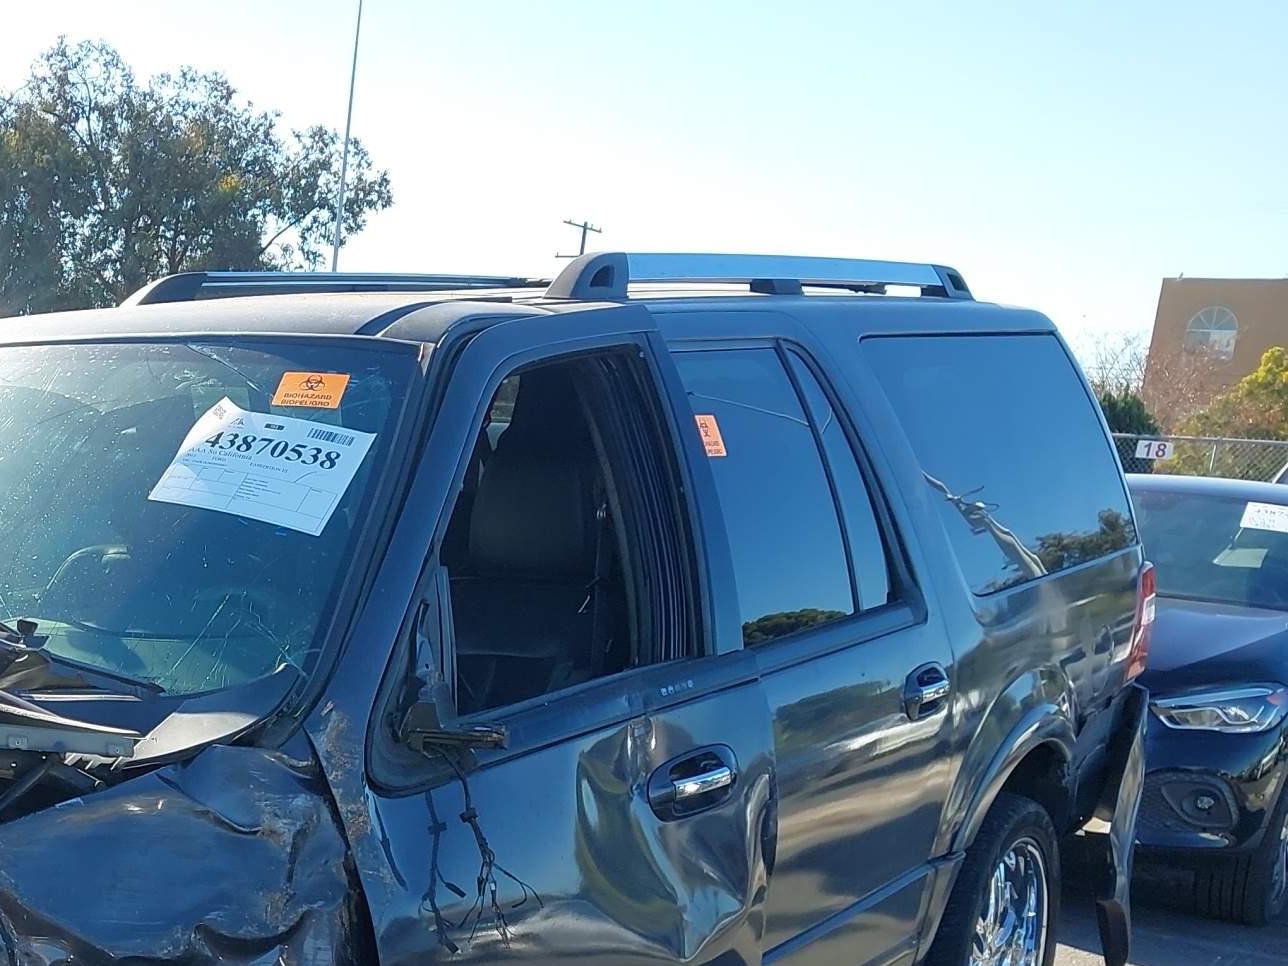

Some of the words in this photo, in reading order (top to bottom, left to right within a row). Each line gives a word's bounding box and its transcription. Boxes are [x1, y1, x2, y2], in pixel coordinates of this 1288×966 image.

[283, 392, 332, 400] BIOHAZARD
[280, 399, 330, 407] BIOPELIGRO
[205, 431, 341, 470] 43870538
[219, 450, 253, 460] California
[1144, 442, 1167, 458] 18
